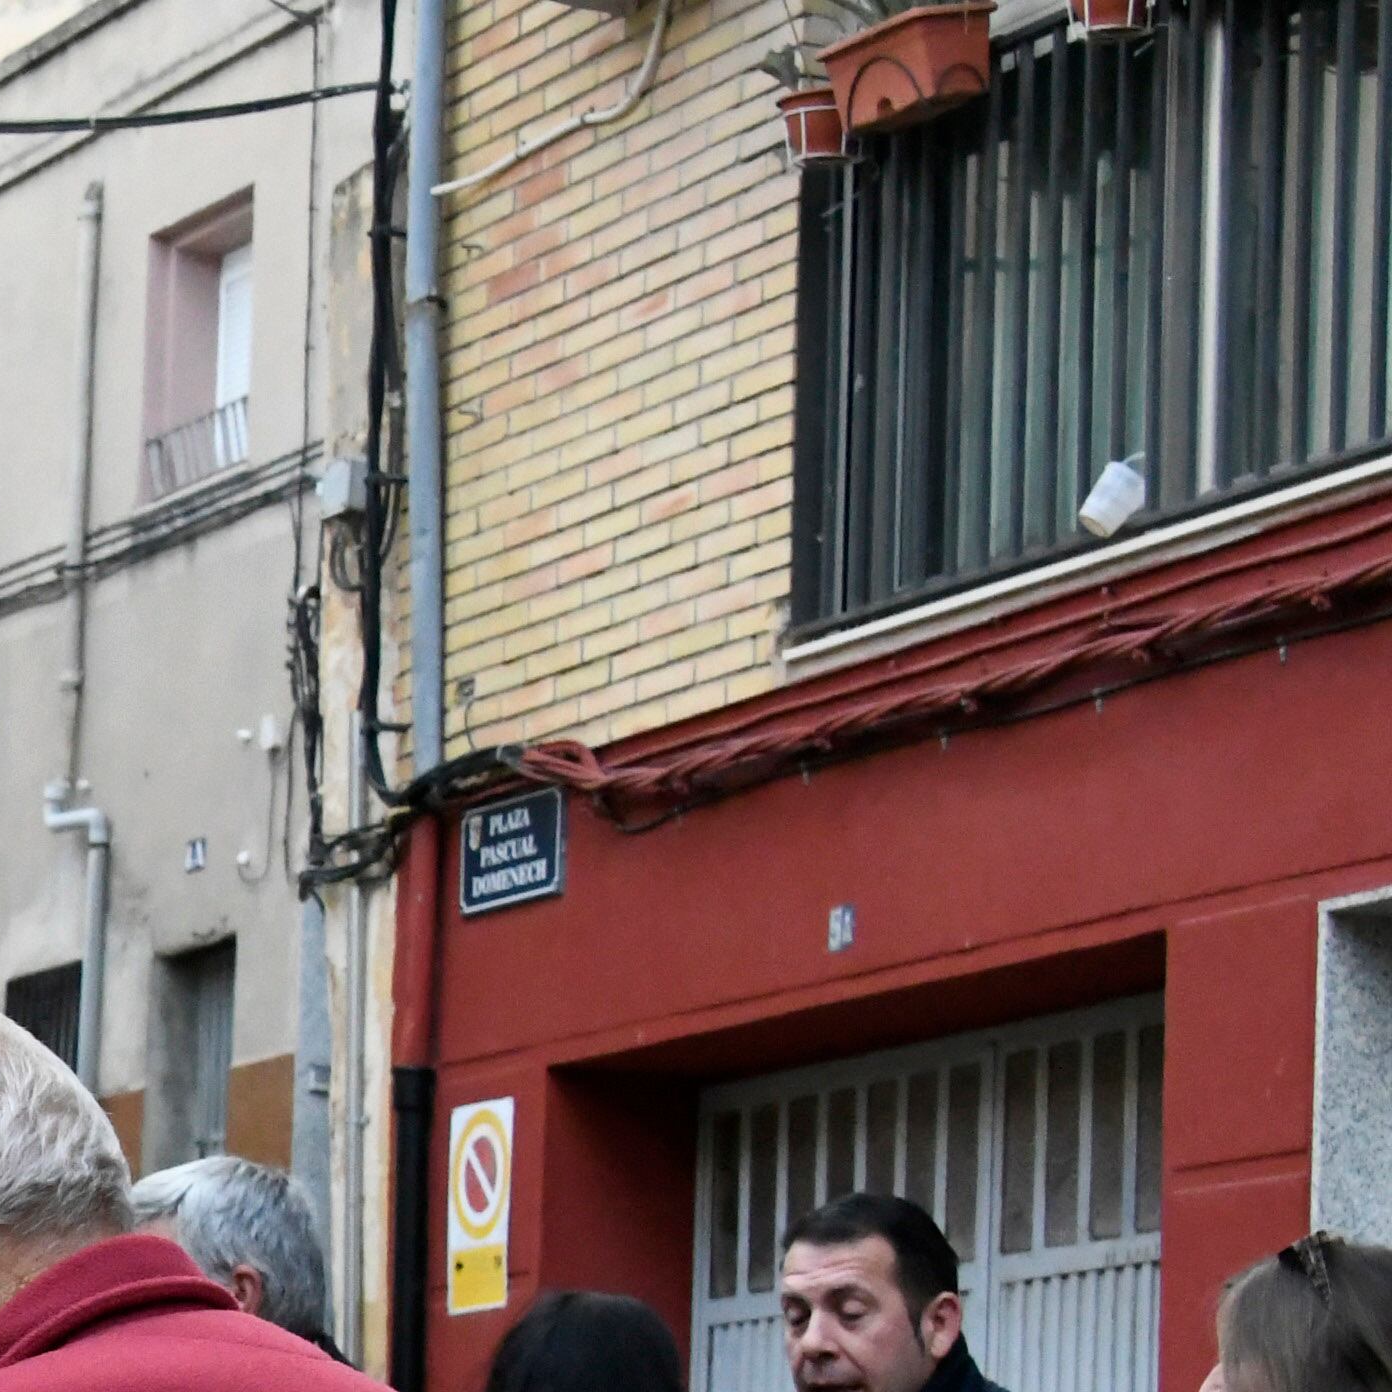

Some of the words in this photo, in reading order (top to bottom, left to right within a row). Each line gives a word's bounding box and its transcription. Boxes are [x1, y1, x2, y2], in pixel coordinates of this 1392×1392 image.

[489, 807, 530, 837] PLAZA
[480, 834, 538, 868] PASCUAL
[472, 857, 547, 898] DOMENECH
